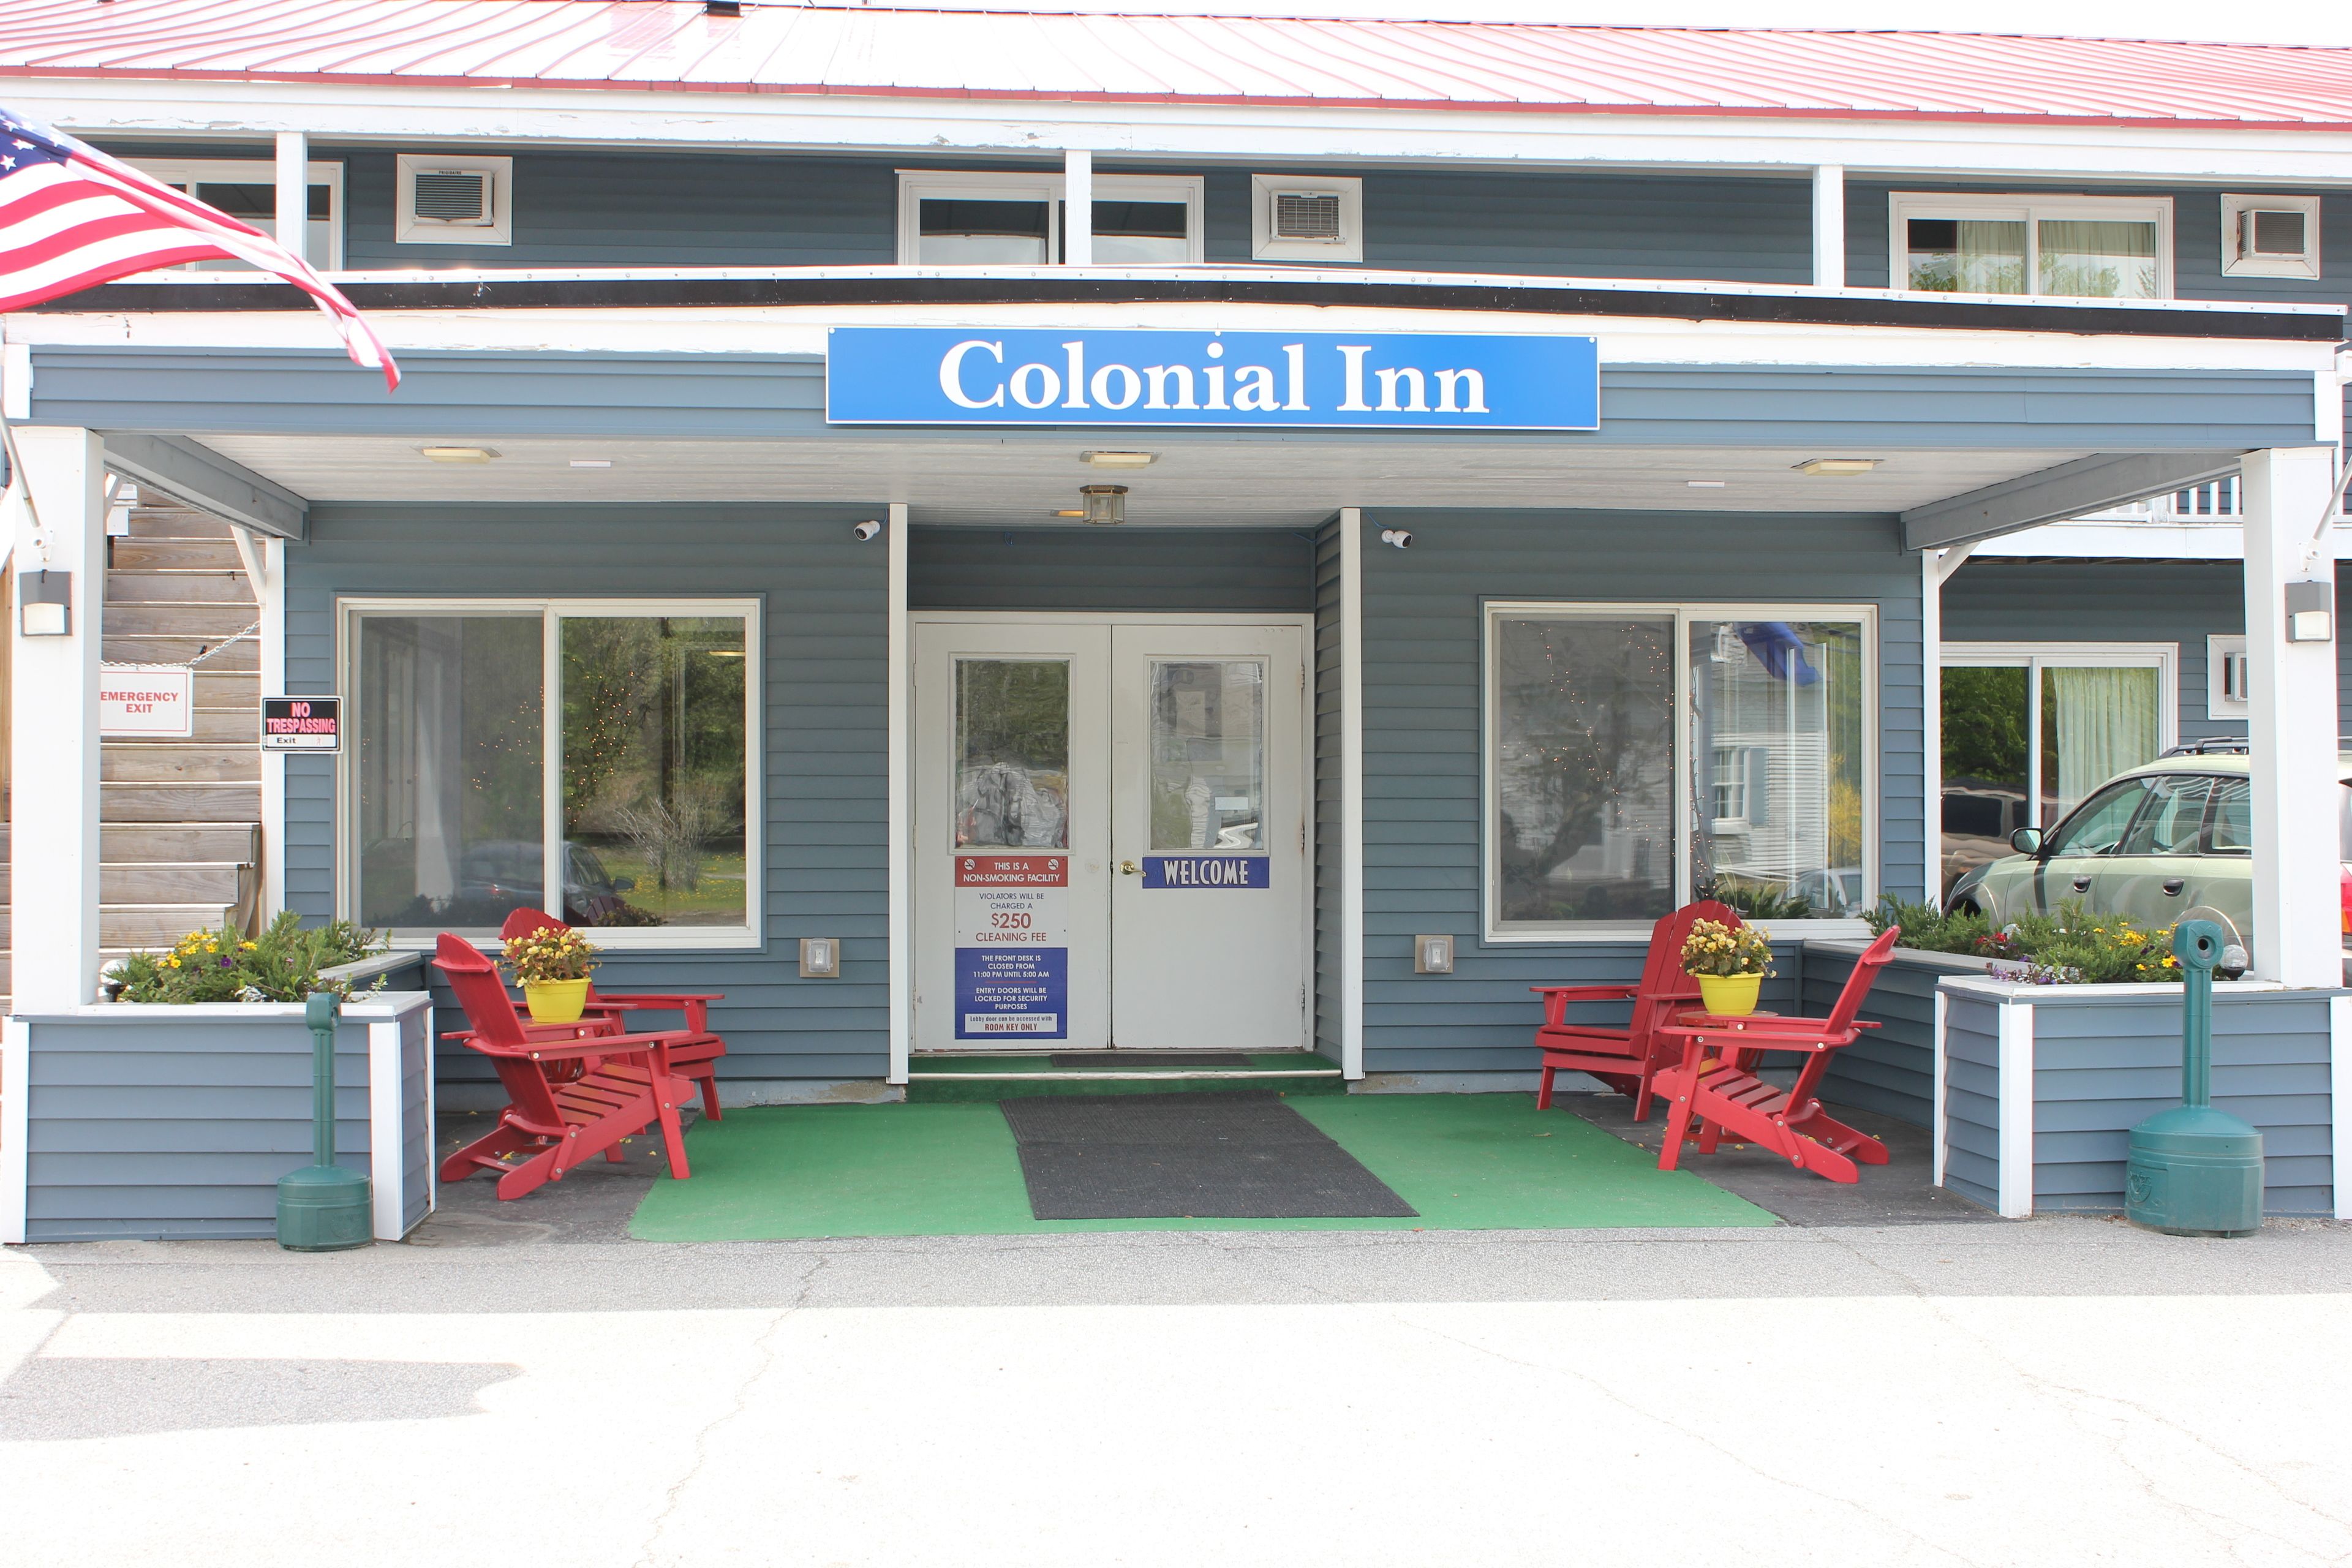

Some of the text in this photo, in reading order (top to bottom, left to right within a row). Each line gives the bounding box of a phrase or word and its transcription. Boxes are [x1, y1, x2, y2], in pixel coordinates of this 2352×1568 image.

[940, 340, 1490, 413] Colonial Inn
[100, 692, 179, 702] EMERGENCY
[126, 704, 153, 713] EXIT
[291, 702, 311, 717] NO
[266, 718, 336, 733] TRESPASSING
[1164, 859, 1248, 885] WELCOME
[991, 913, 1031, 929] $250
[976, 933, 1046, 941] CLEANING FEE
